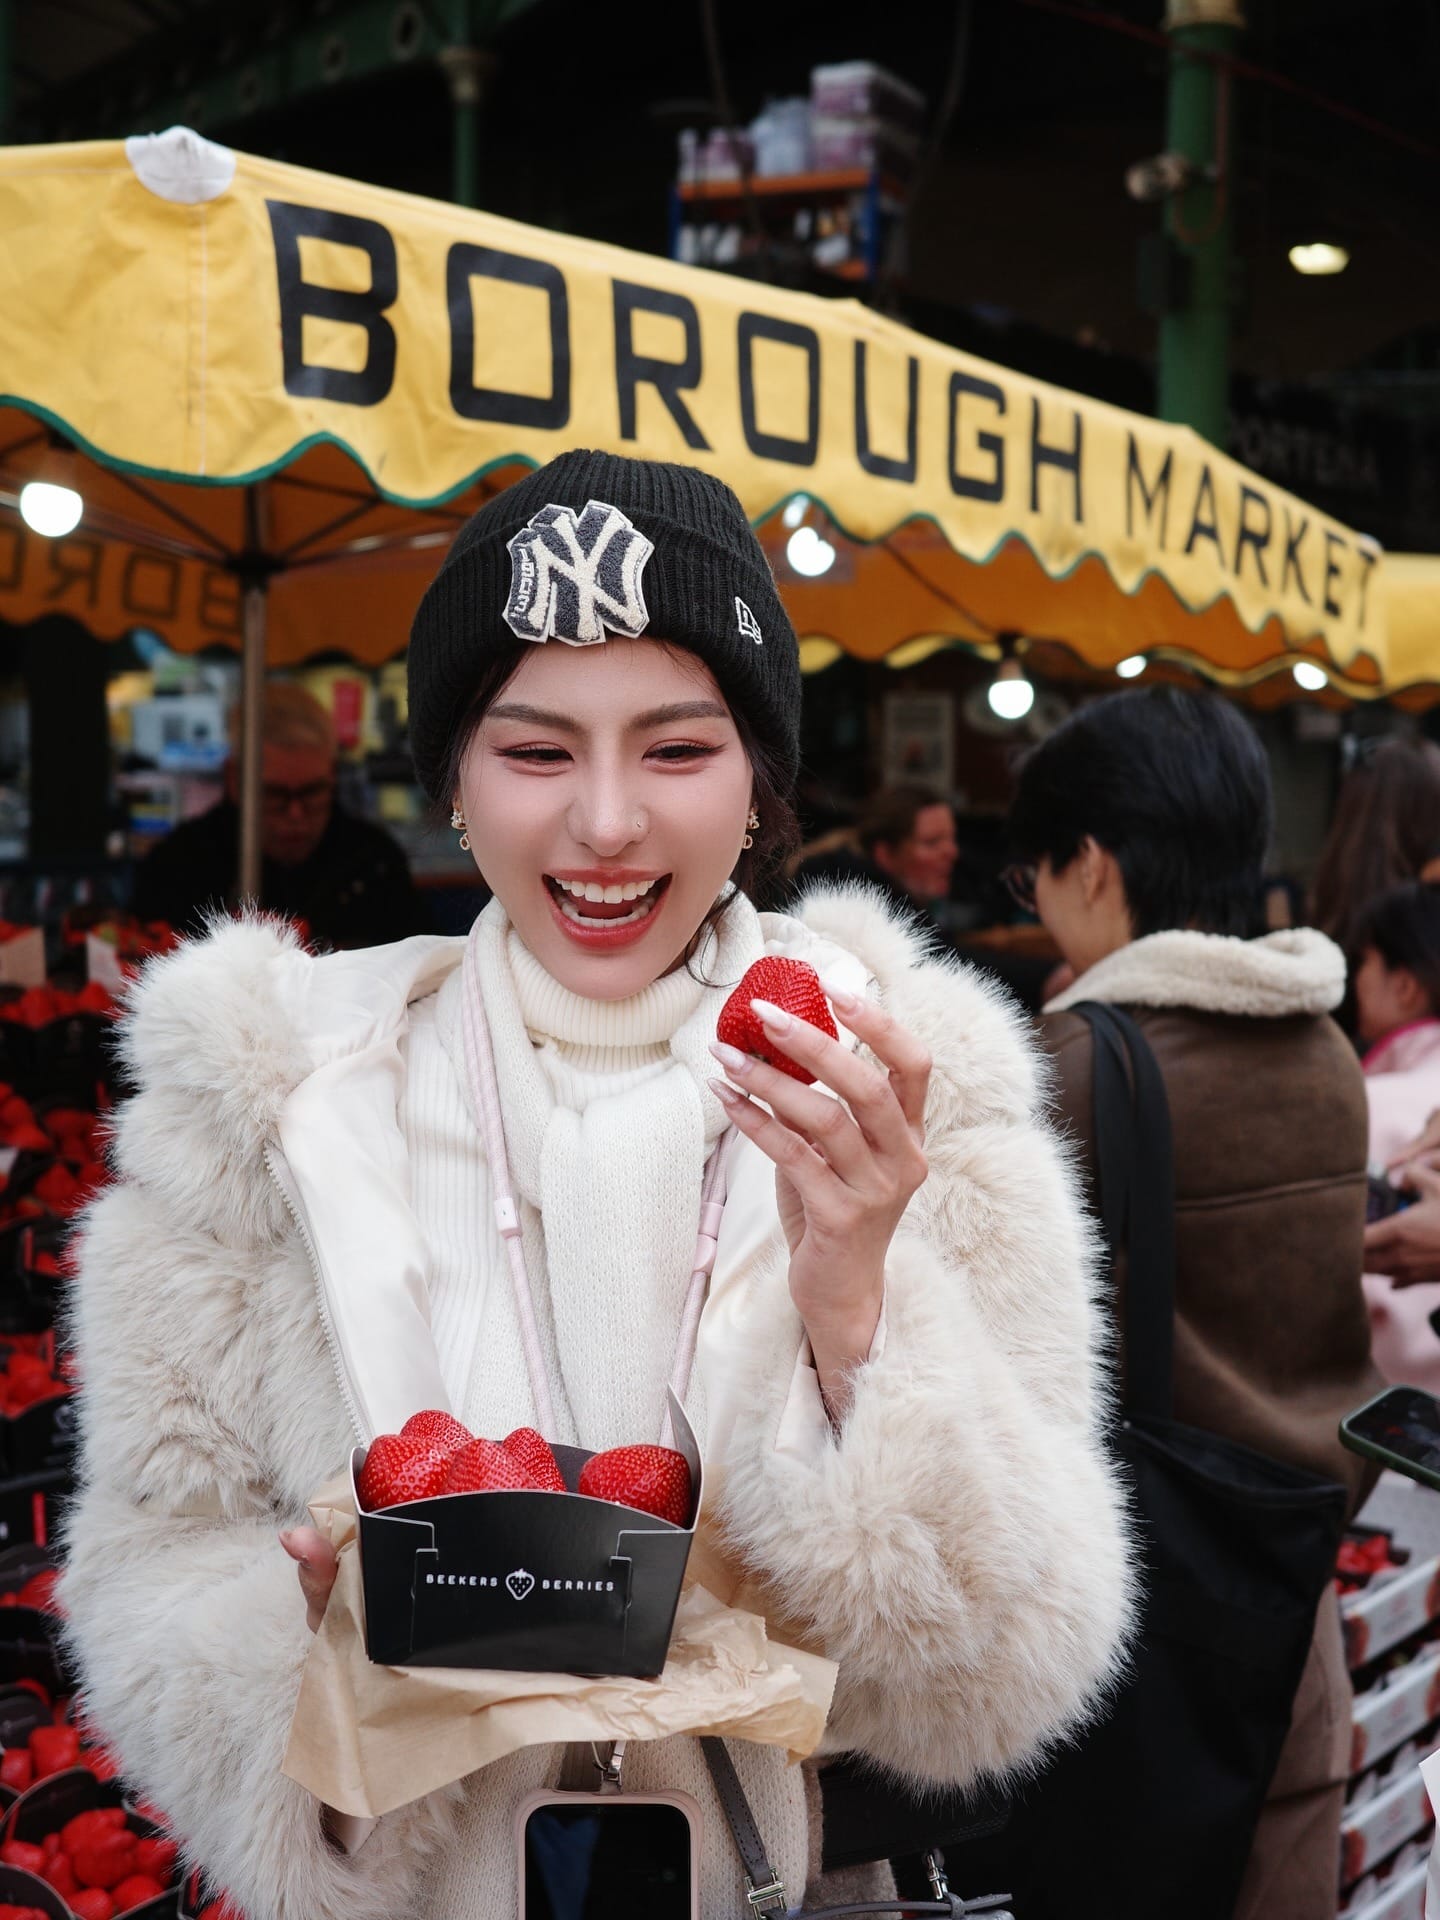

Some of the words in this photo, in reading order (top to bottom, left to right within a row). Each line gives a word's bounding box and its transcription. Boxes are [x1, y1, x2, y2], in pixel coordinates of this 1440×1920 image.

[266, 198, 1083, 524] BOROUGH
[1126, 429, 1378, 630] MARKET
[522, 505, 650, 644] NY
[426, 1573, 498, 1587] BEEKERS
[542, 1579, 614, 1593] BERRIES
